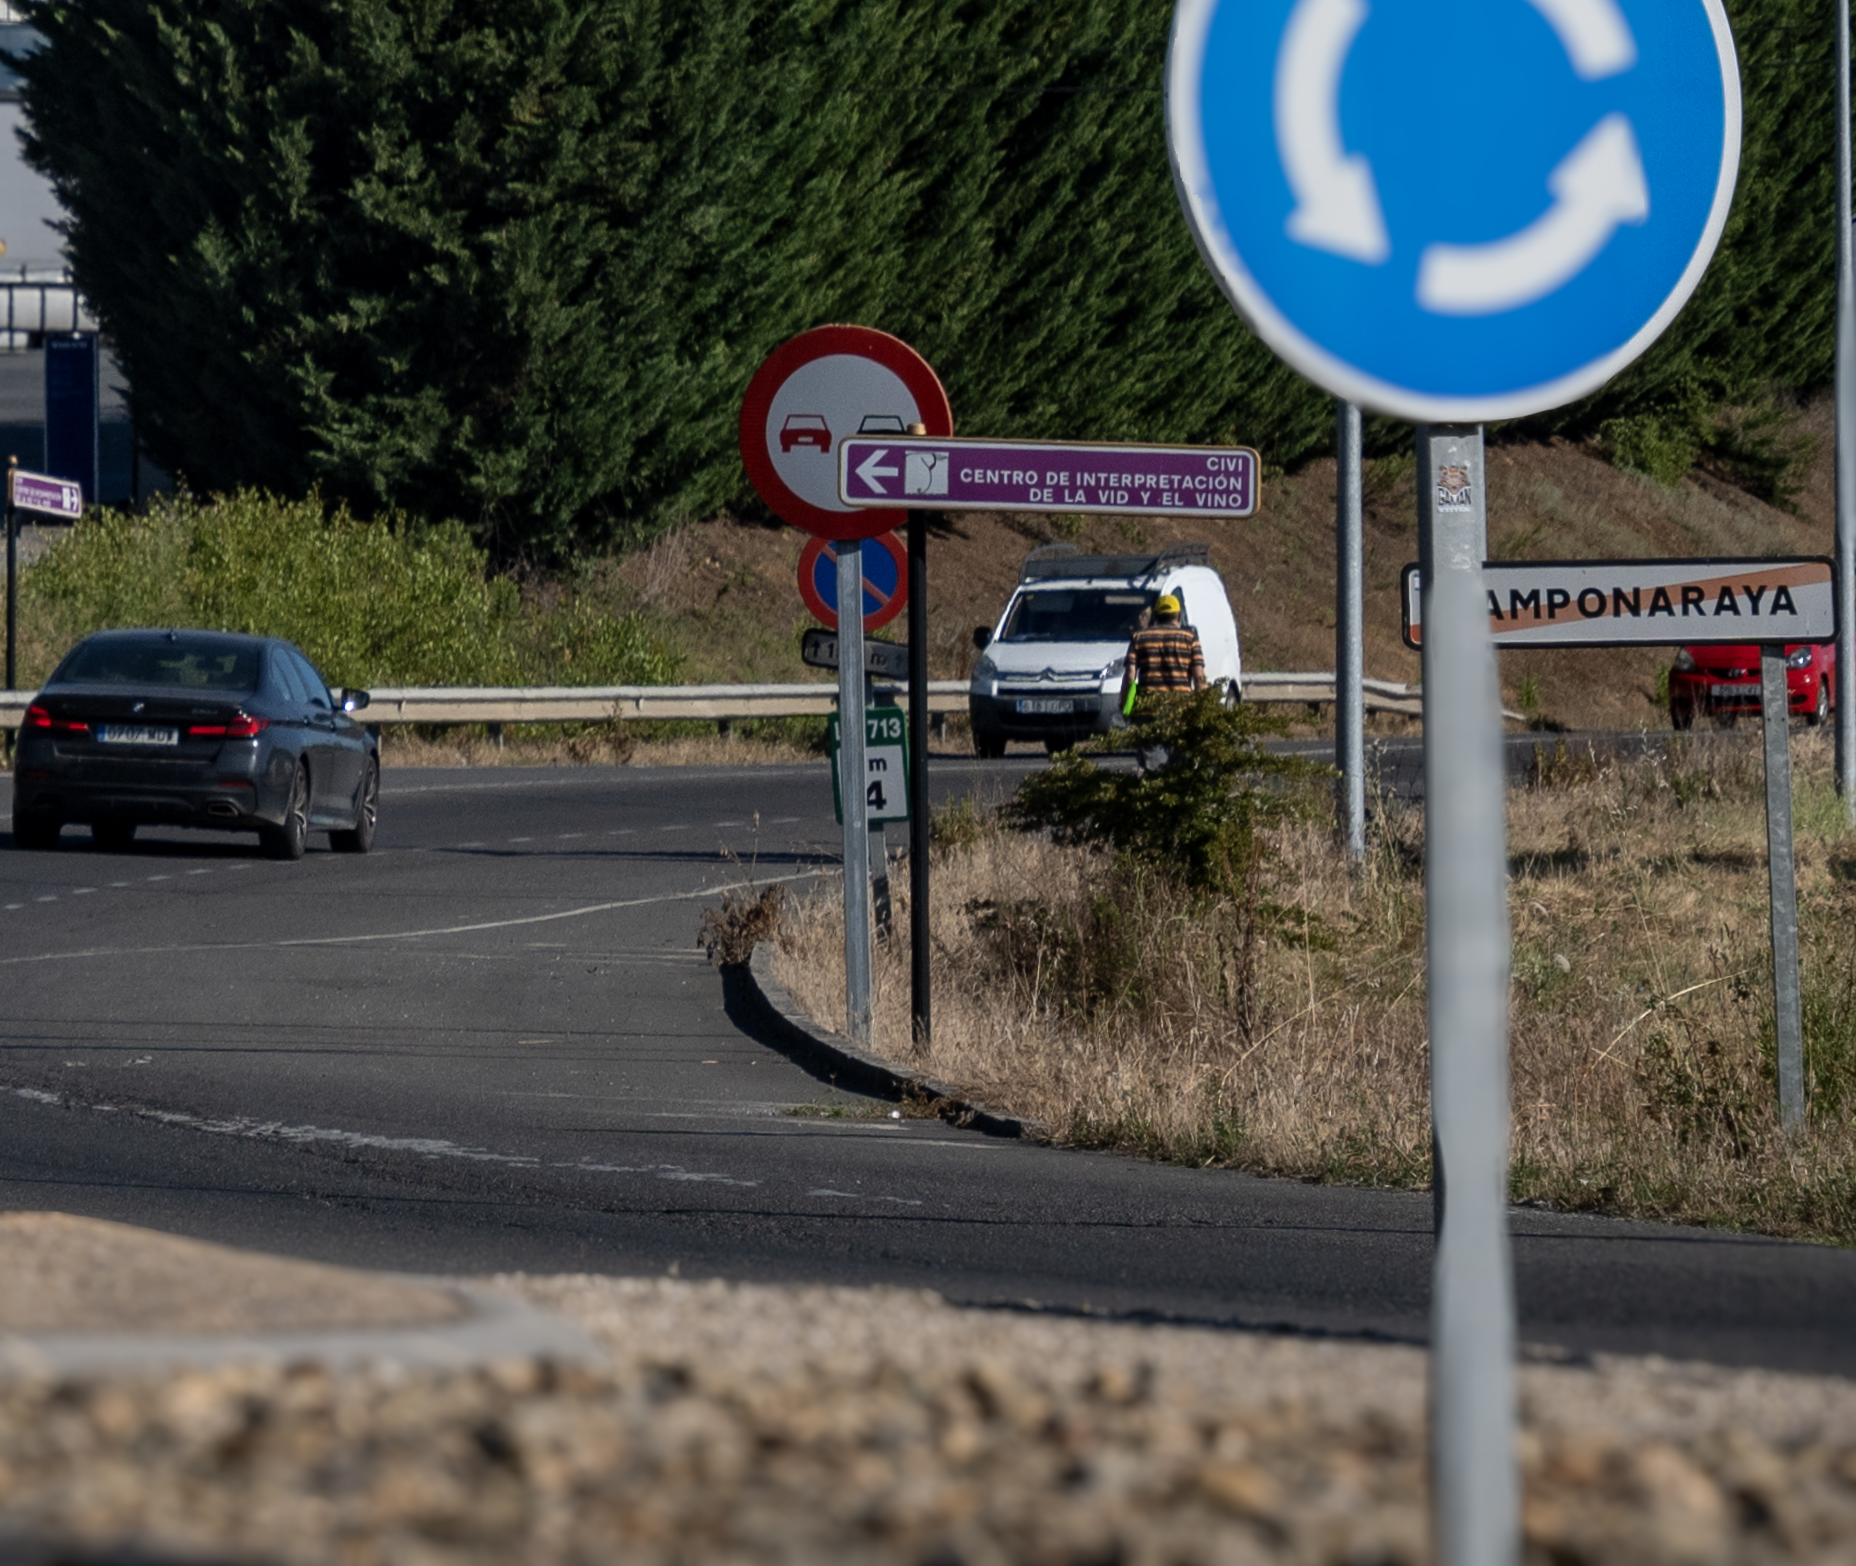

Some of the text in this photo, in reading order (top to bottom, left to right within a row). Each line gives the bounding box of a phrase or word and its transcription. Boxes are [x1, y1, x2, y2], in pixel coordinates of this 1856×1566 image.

[1206, 456, 1244, 473] CIVI
[959, 468, 1243, 491] CENTRO DE INTERPRETACIÓN
[1028, 487, 1243, 508] DE LA VID Y EL VINO
[1486, 584, 1797, 621] AMPONARAYA
